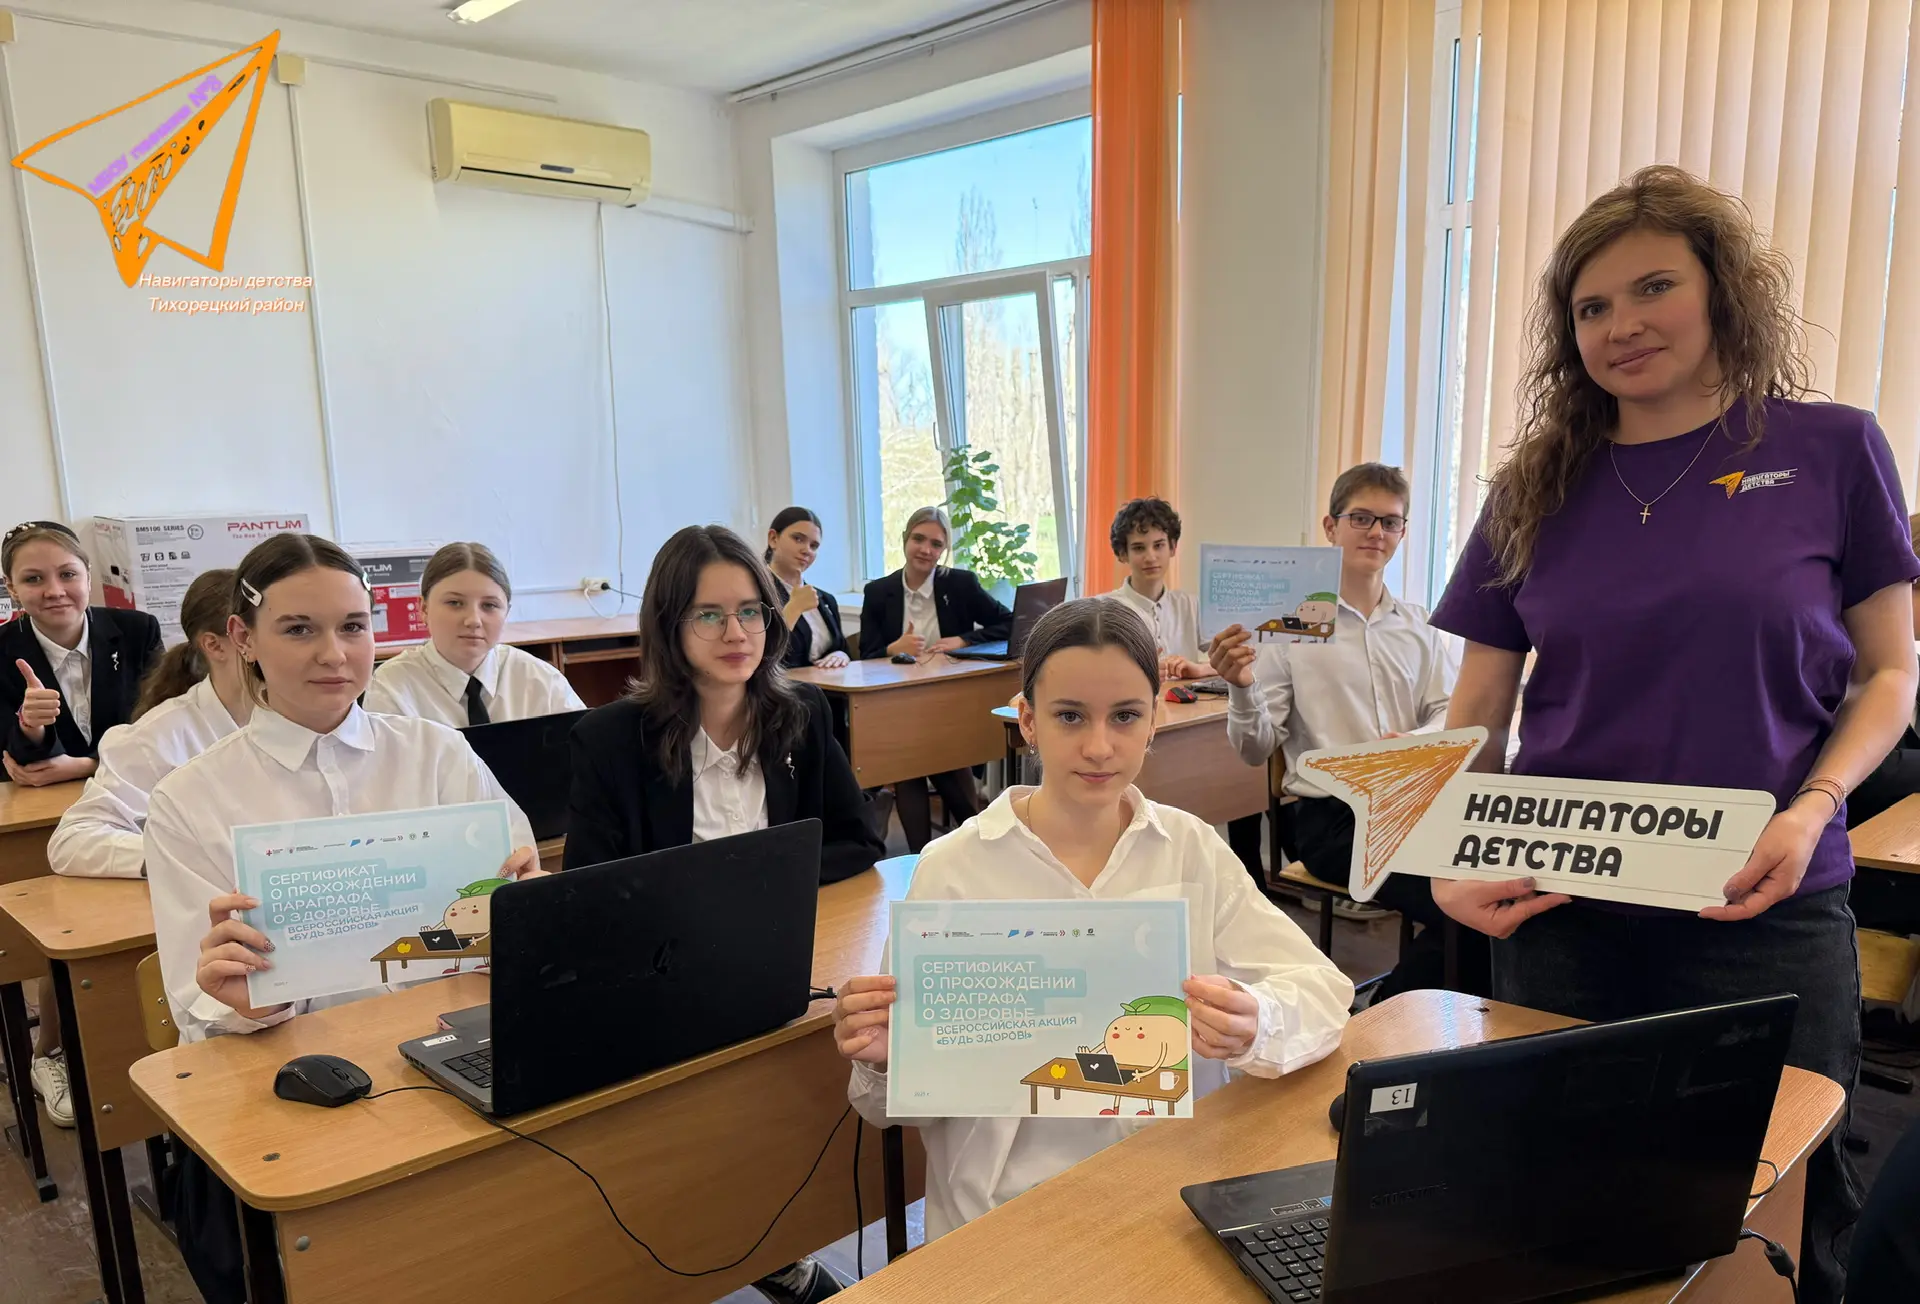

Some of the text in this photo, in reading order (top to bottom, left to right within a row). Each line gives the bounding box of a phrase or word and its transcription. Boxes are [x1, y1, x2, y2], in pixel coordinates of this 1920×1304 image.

[227, 520, 302, 532] PANTUM
[1464, 793, 1724, 840] НАВИГАТОРЫ
[1452, 834, 1622, 877] ДЕТСТВА
[269, 864, 379, 886] СЕРТИФИКАТ
[270, 873, 416, 900] О ПРОХОЖДЕНИИ
[272, 892, 373, 912] ПАРАГРАФА
[273, 903, 381, 925] О ЗДОРОВЬЕ
[288, 905, 419, 934] ВСЕРОССИЙСКАЯ АКЦИЯ
[922, 961, 1036, 974] СЕРТИФИКАТ
[922, 976, 1075, 991] О ПРОХОЖДЕНИИ
[923, 992, 1026, 1005] ПАРАГРАФА
[923, 1007, 1035, 1021] О ЗДОРОВЬЕ
[936, 1016, 1077, 1035] ВСЕРОССИЙСКАЯ АКЦИЯ
[1391, 1087, 1411, 1106] 13
